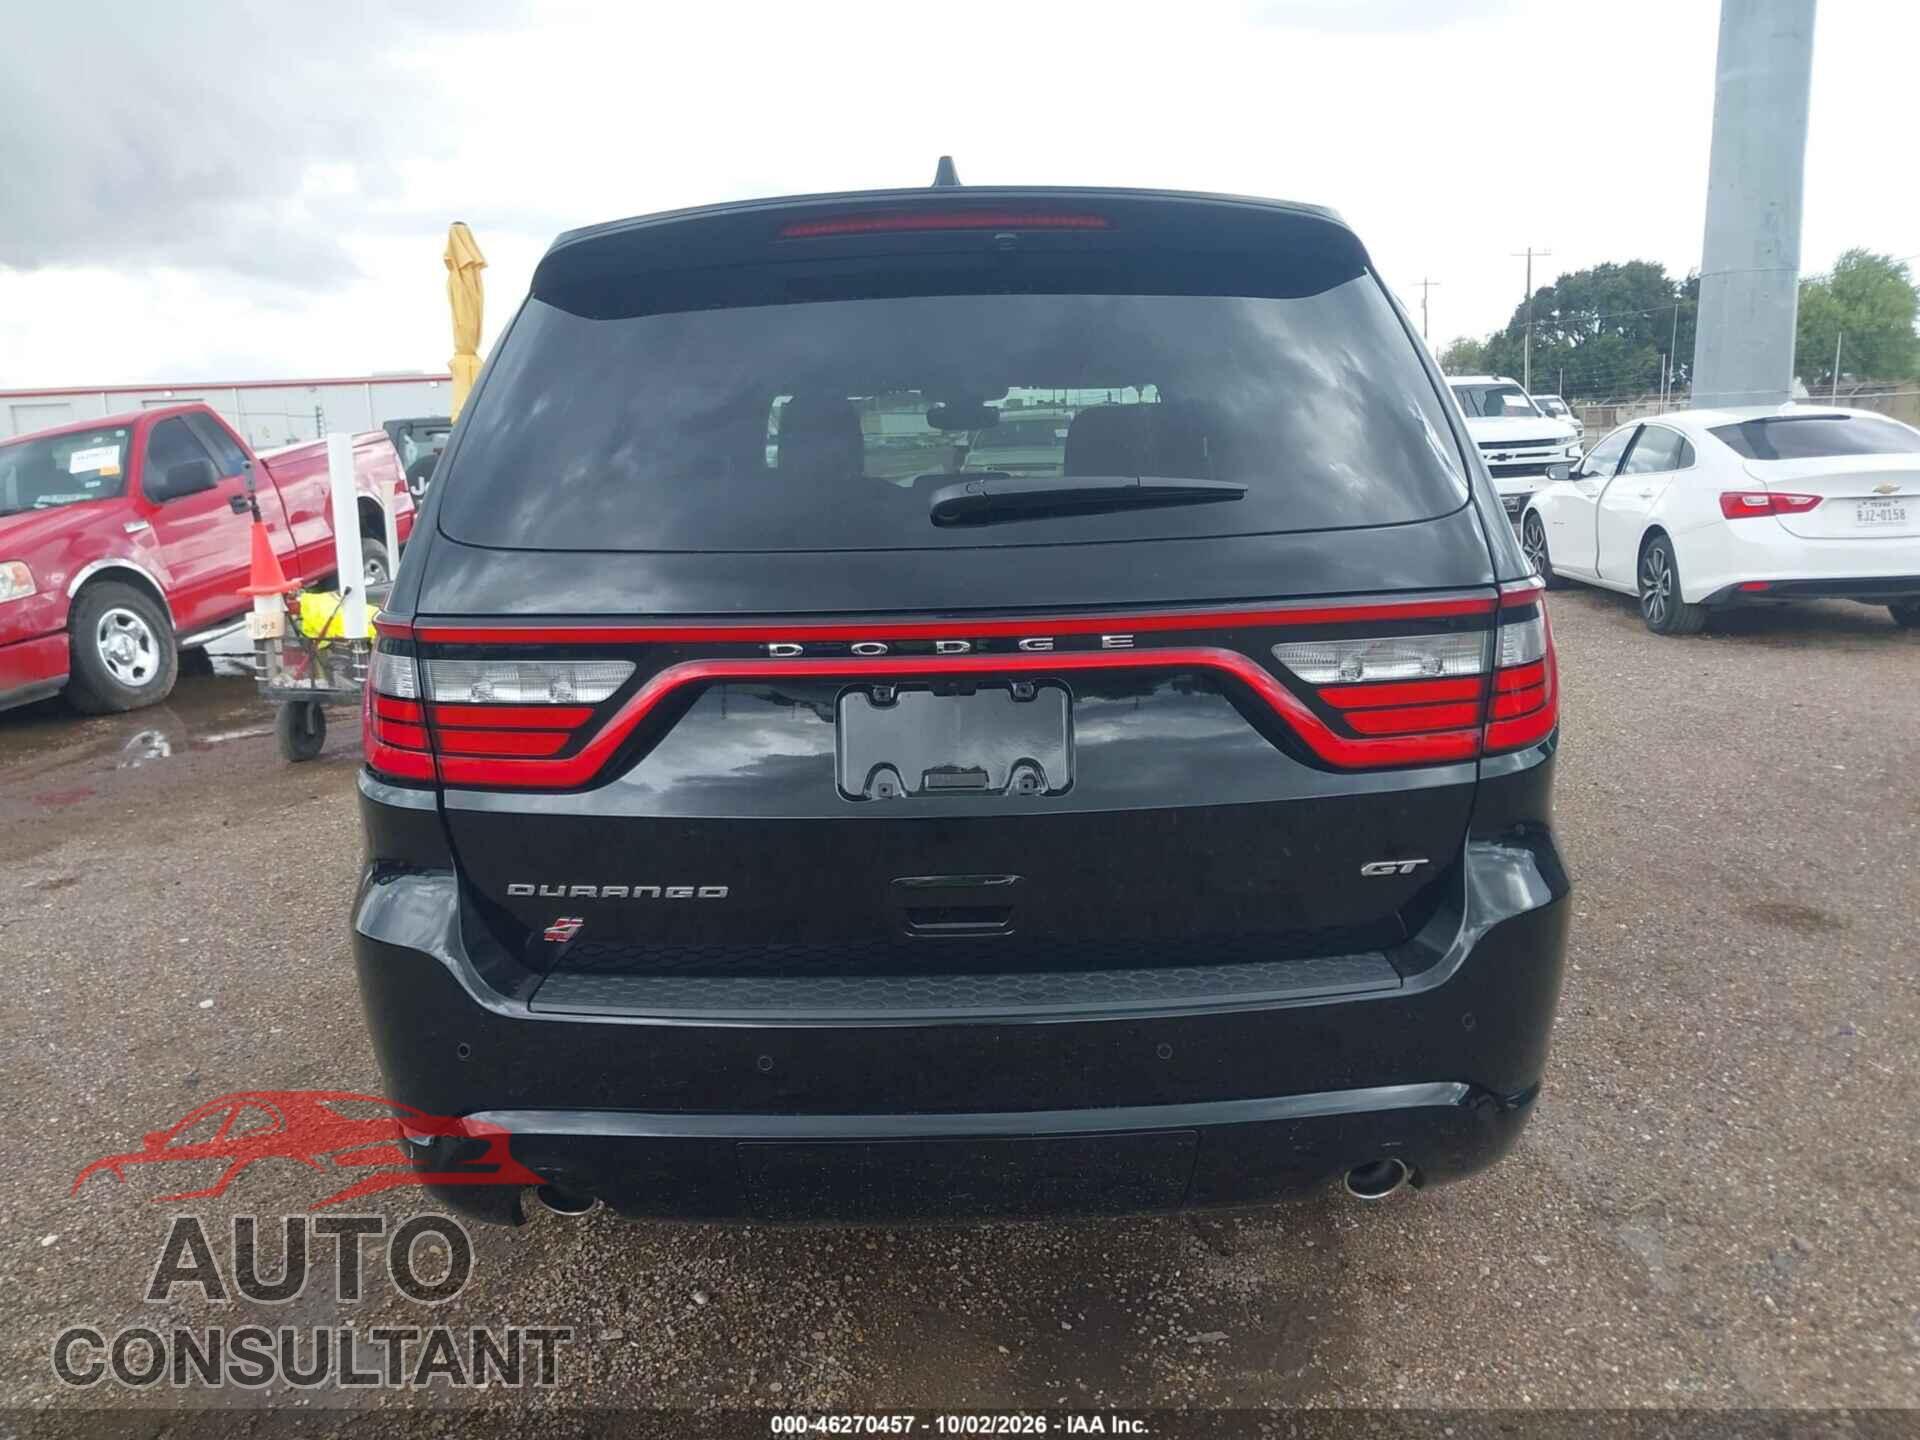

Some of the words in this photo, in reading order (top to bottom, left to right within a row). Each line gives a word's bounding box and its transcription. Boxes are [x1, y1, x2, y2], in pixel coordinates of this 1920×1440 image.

[768, 634, 1135, 657] DODGE
[1360, 858, 1430, 876] GT
[506, 883, 730, 899] DURANGO
